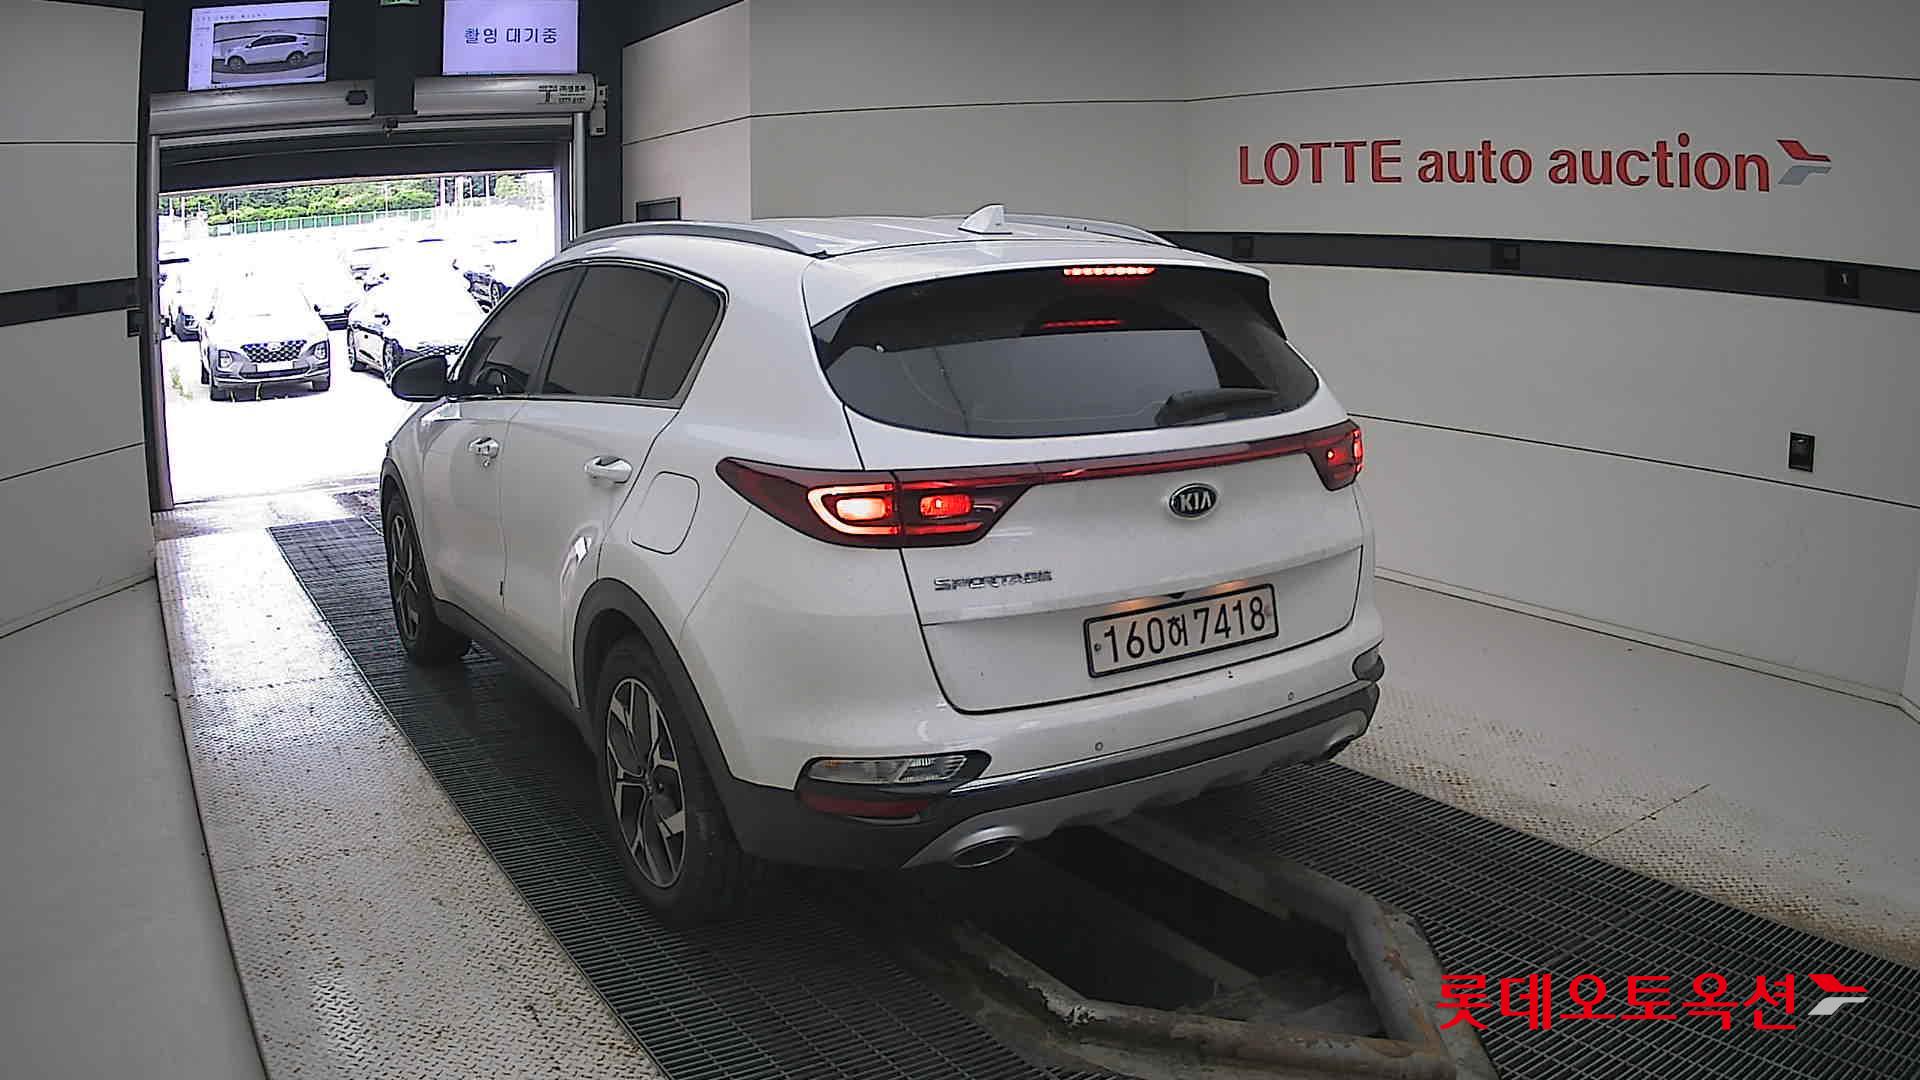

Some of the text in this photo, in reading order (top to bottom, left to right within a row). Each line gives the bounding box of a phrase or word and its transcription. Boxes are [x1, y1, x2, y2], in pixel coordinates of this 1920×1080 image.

[506, 27, 557, 45] 대기중
[1238, 132, 1771, 192] LOTTE auto auction
[1180, 490, 1212, 512] KIA
[934, 570, 1052, 591] SPORTAGE
